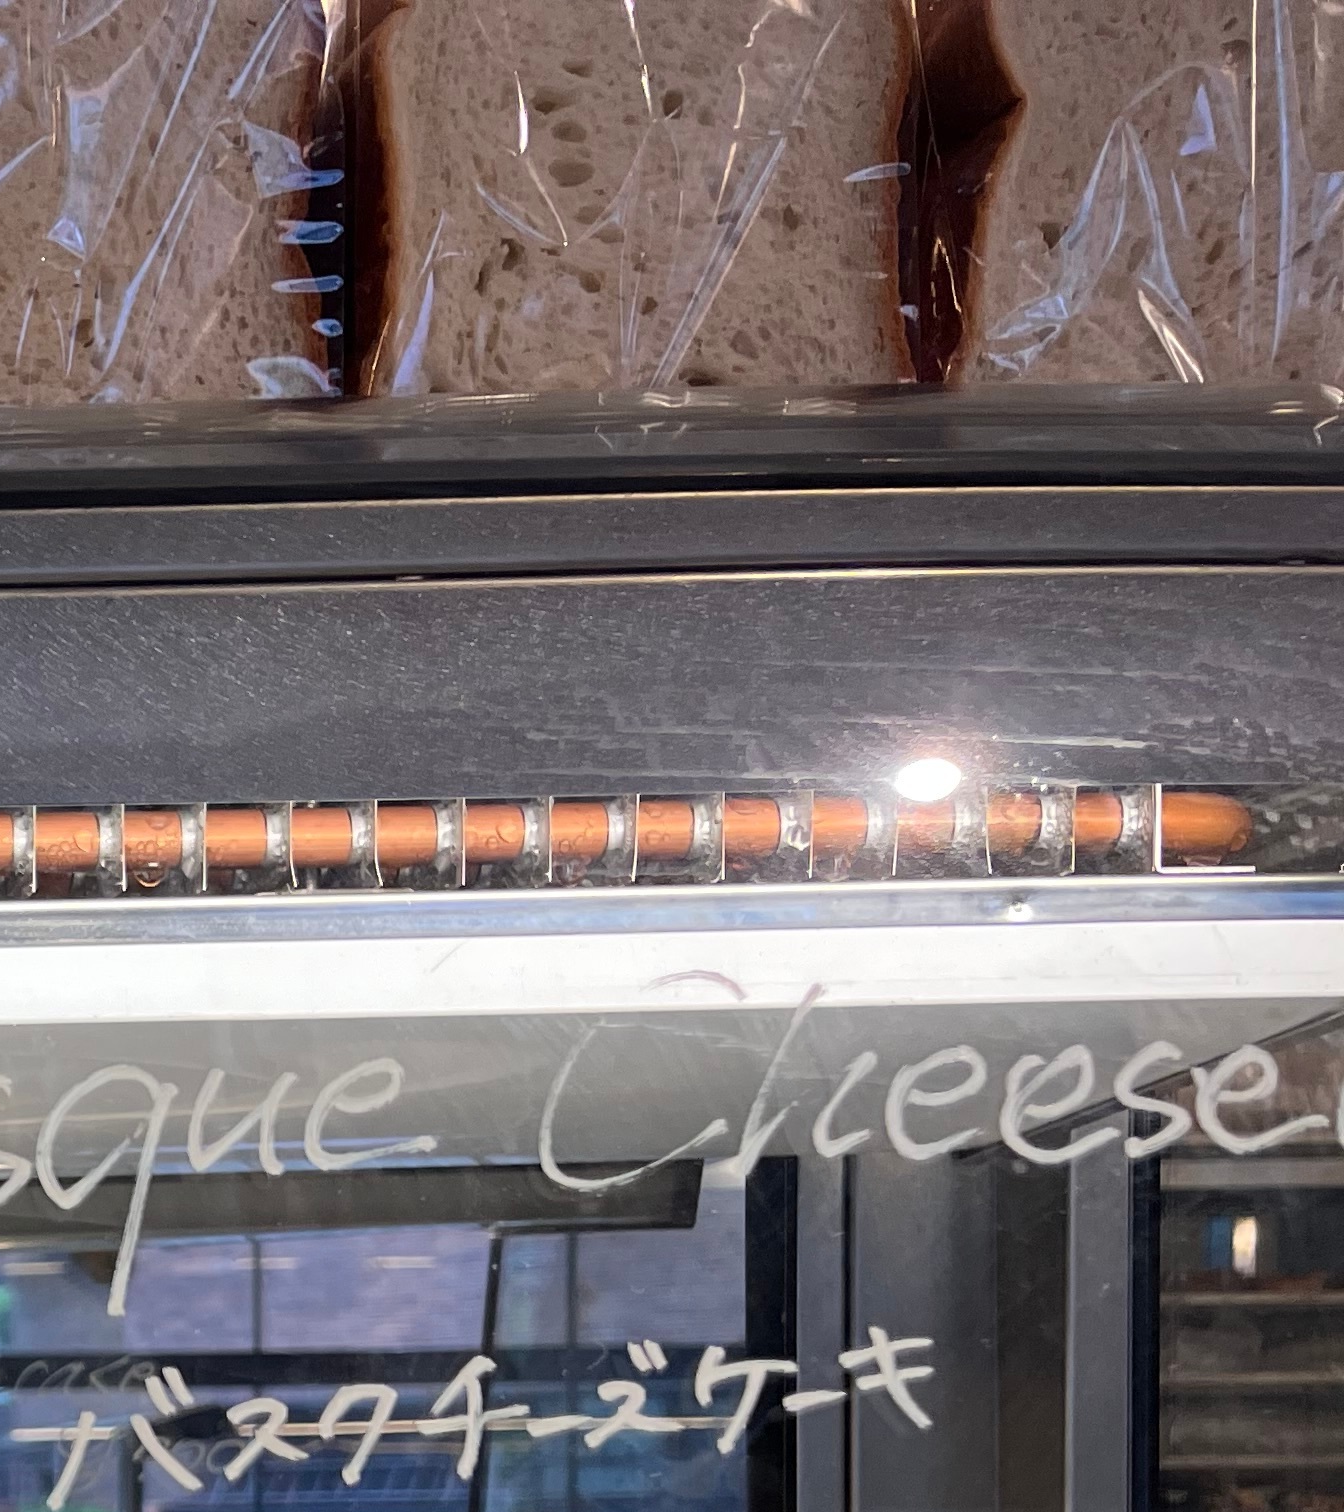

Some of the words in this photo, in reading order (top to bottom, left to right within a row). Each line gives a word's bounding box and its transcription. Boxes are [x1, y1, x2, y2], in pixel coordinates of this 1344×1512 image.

[10, 1325, 934, 1512] バスクチーズケーキ
